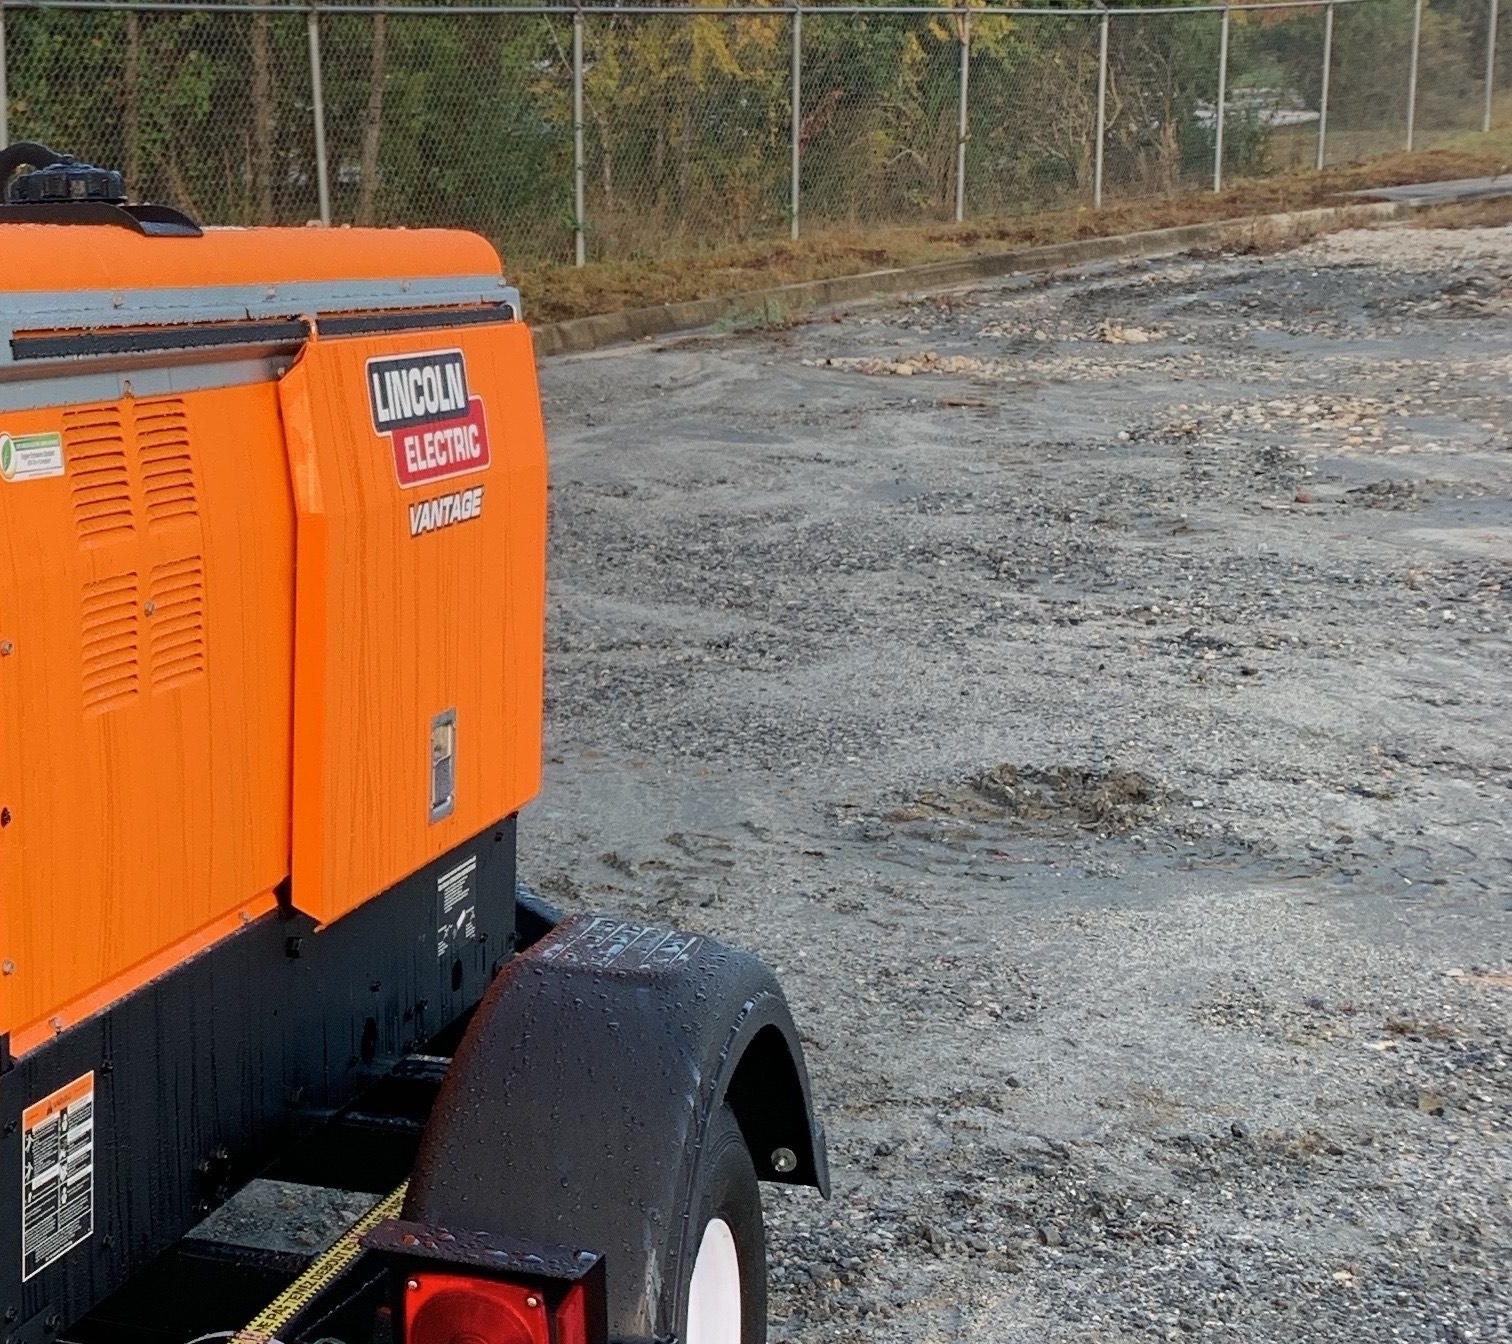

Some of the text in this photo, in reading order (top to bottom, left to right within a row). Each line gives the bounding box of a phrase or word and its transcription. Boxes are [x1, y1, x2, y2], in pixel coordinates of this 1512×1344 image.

[373, 362, 466, 422] LINCOLN
[403, 423, 481, 473] ELECTRIC
[408, 485, 484, 537] VANTAGE
